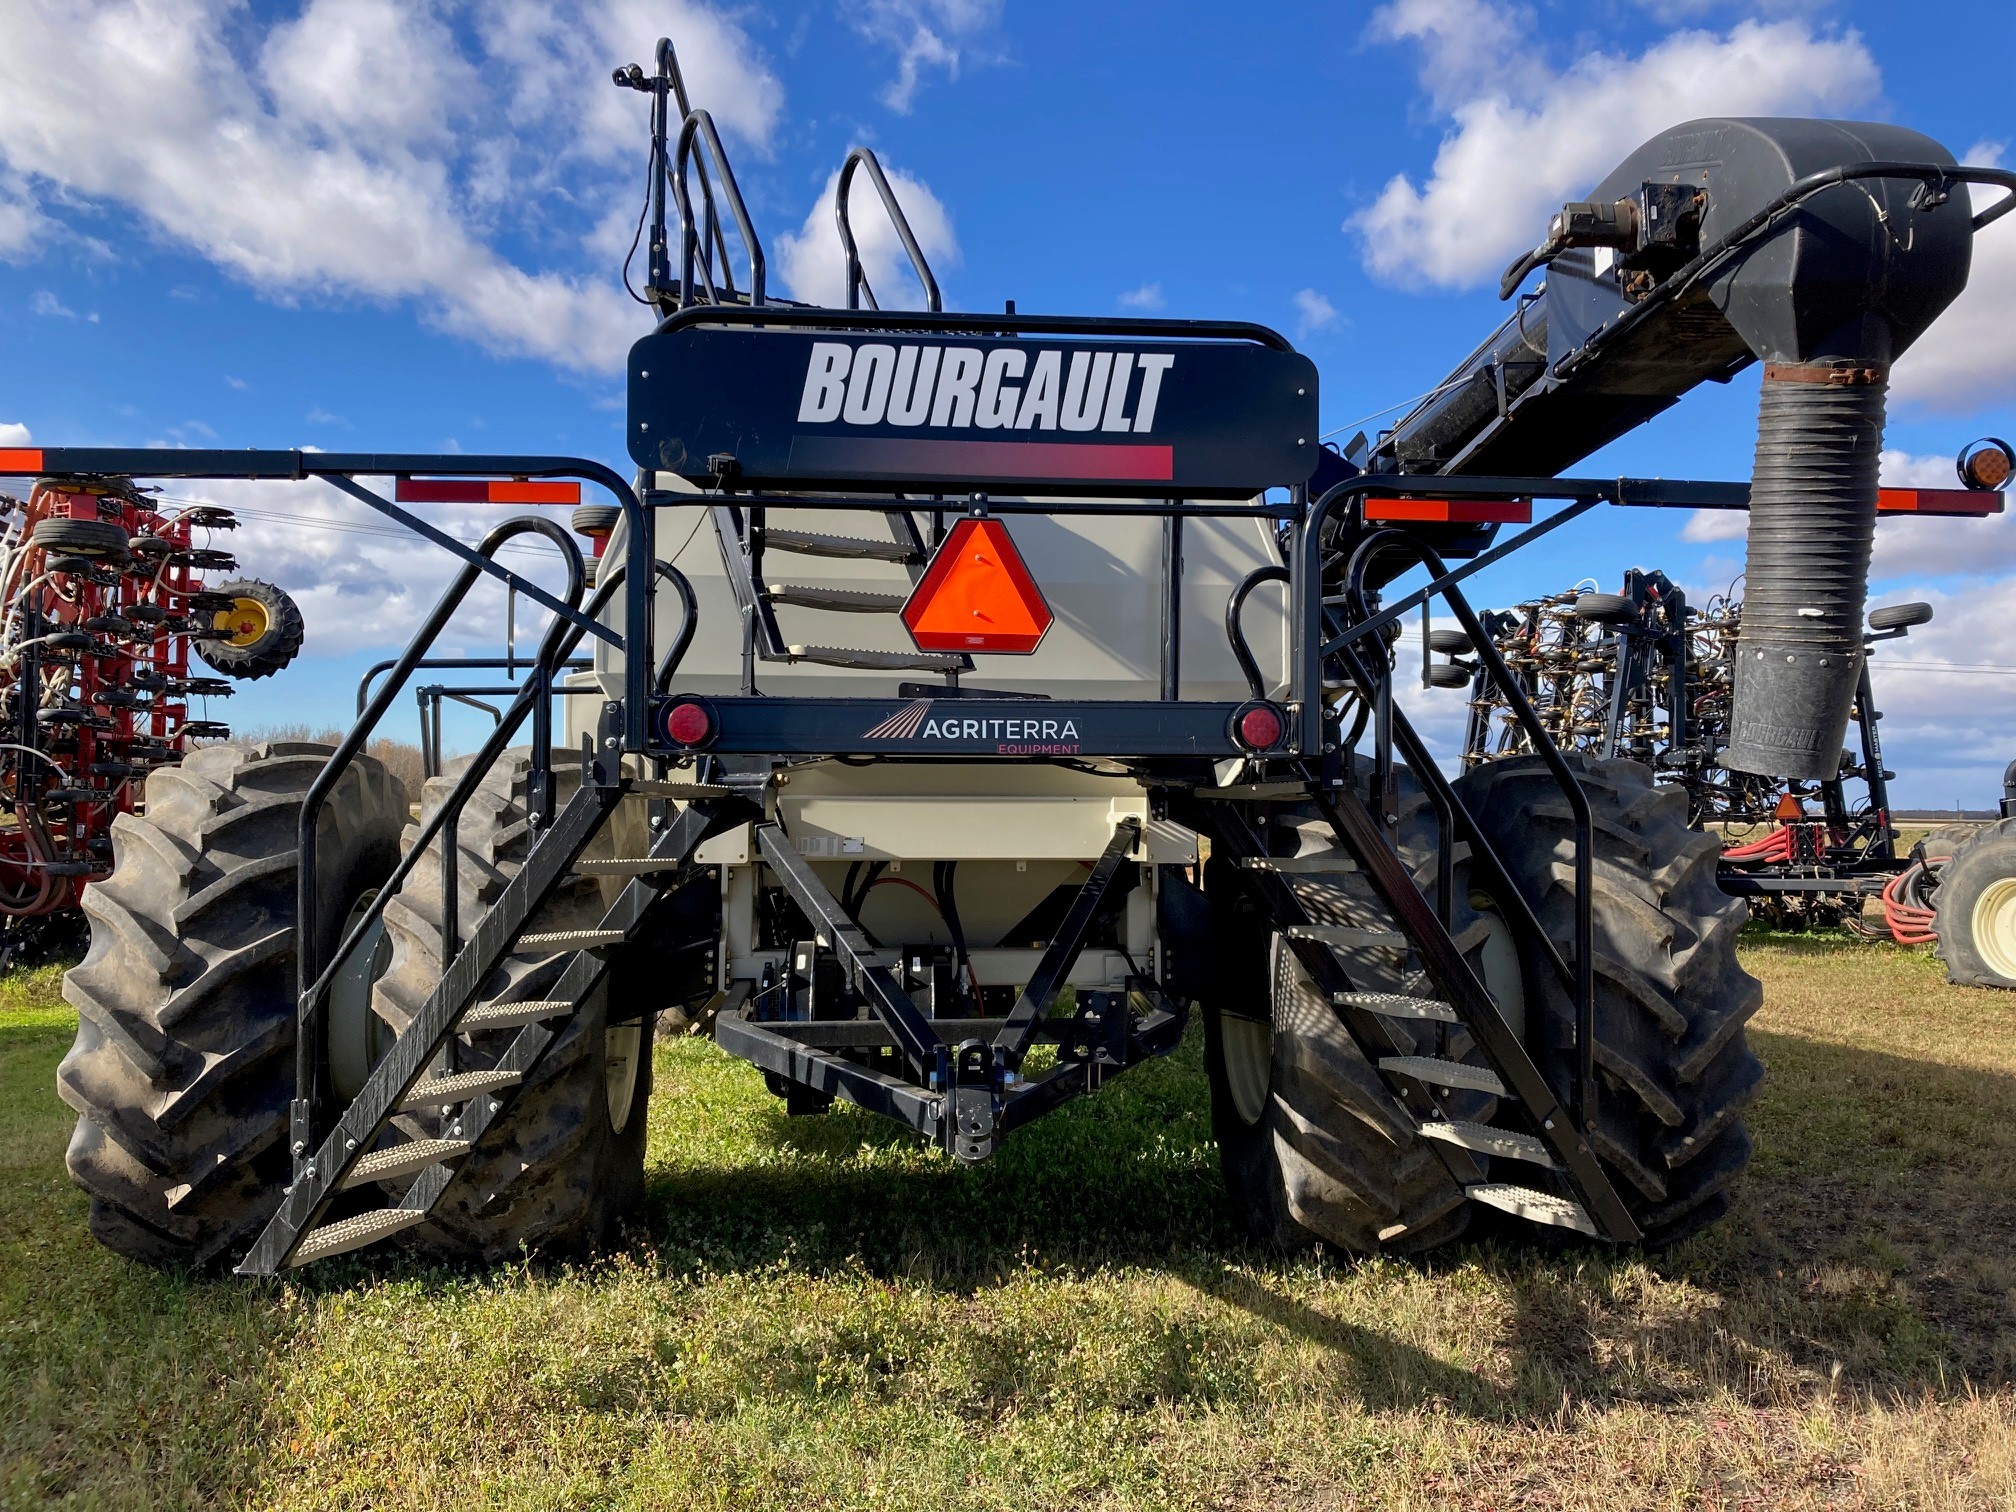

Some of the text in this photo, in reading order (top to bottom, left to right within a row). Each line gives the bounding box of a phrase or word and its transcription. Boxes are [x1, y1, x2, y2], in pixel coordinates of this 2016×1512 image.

[797, 342, 1175, 433] BOURGAULT
[922, 719, 1079, 739] AGRITERRA
[998, 744, 1079, 754] EQUIPMENT
[1871, 725, 1884, 778] SEED MASTER
